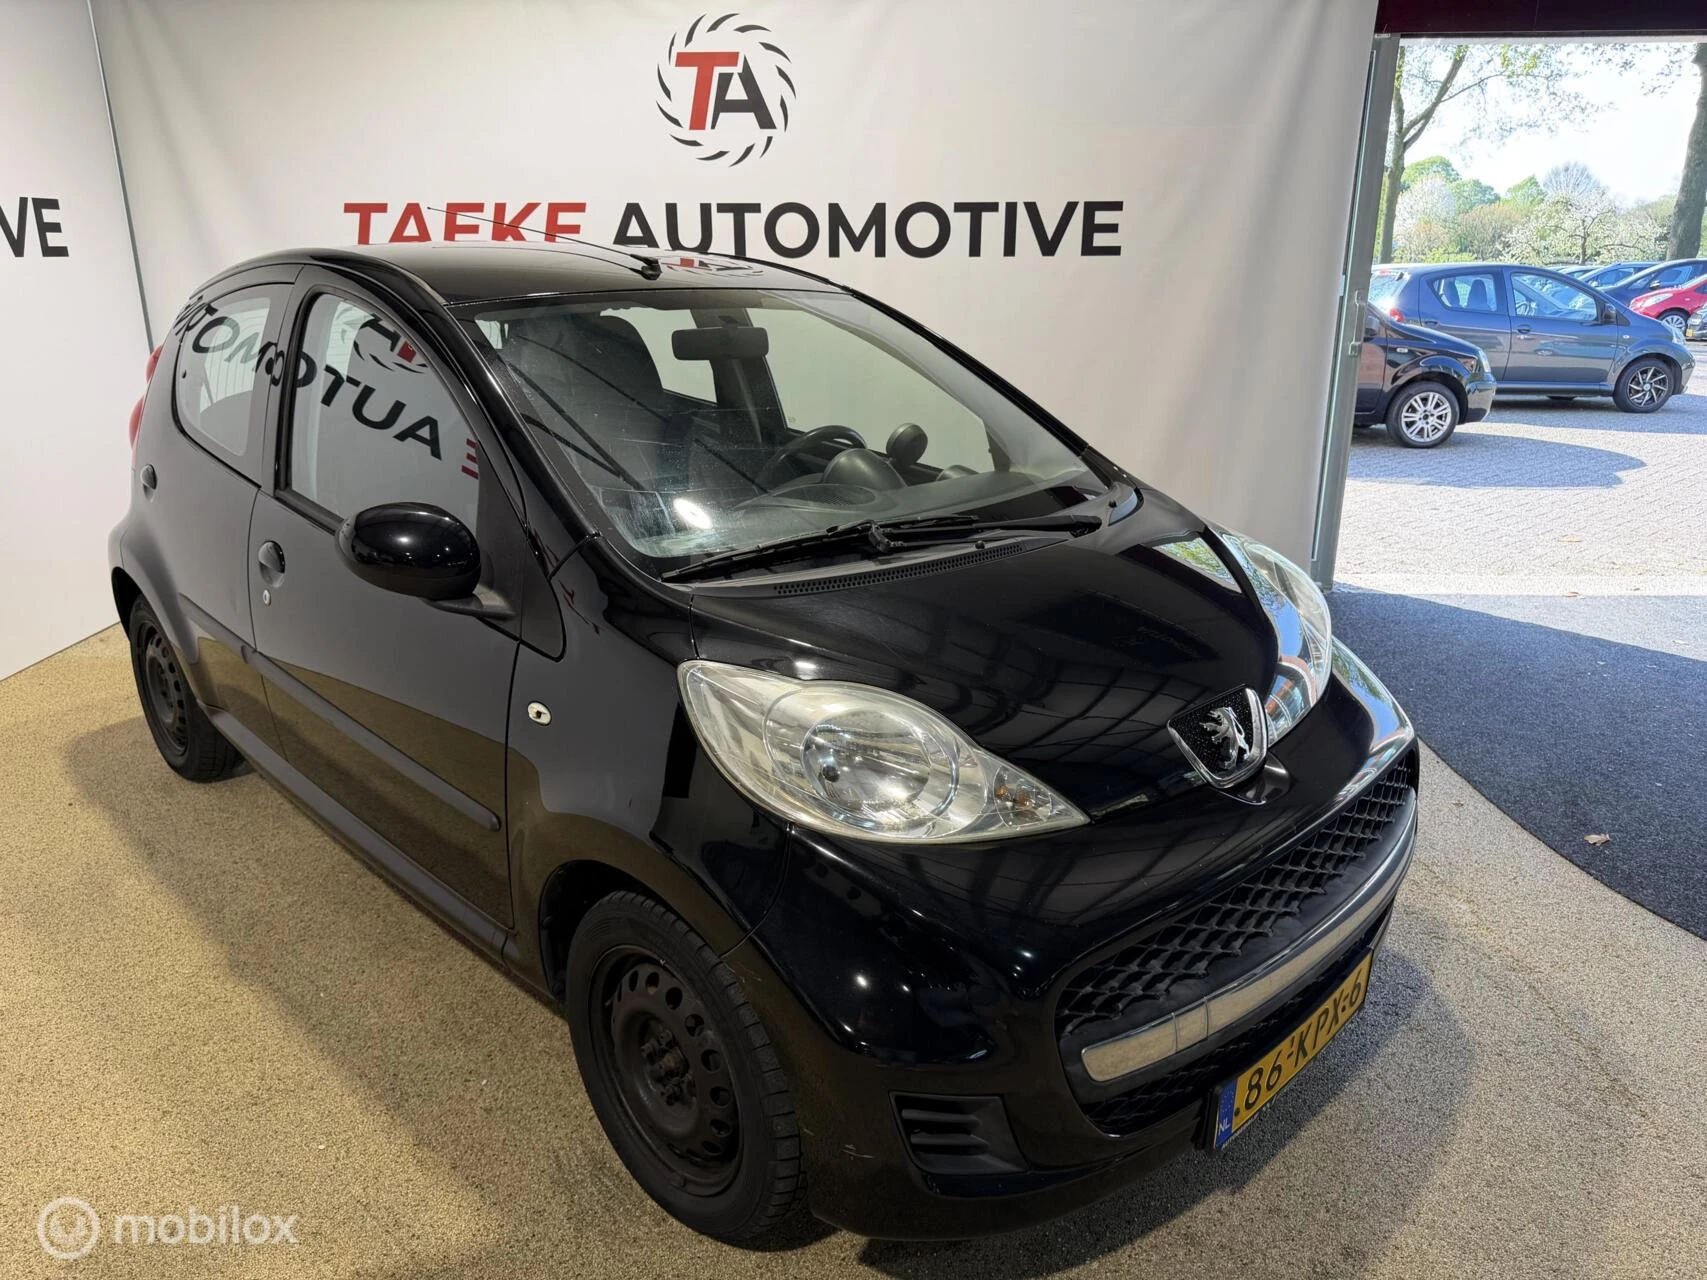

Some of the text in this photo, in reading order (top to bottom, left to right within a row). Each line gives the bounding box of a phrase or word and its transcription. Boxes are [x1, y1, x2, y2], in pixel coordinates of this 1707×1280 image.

[674, 51, 778, 131] TA
[612, 201, 1124, 259] AUTOMOTIVE
[1243, 967, 1363, 1112] 86-KPX-6
[1218, 1120, 1231, 1136] NL
